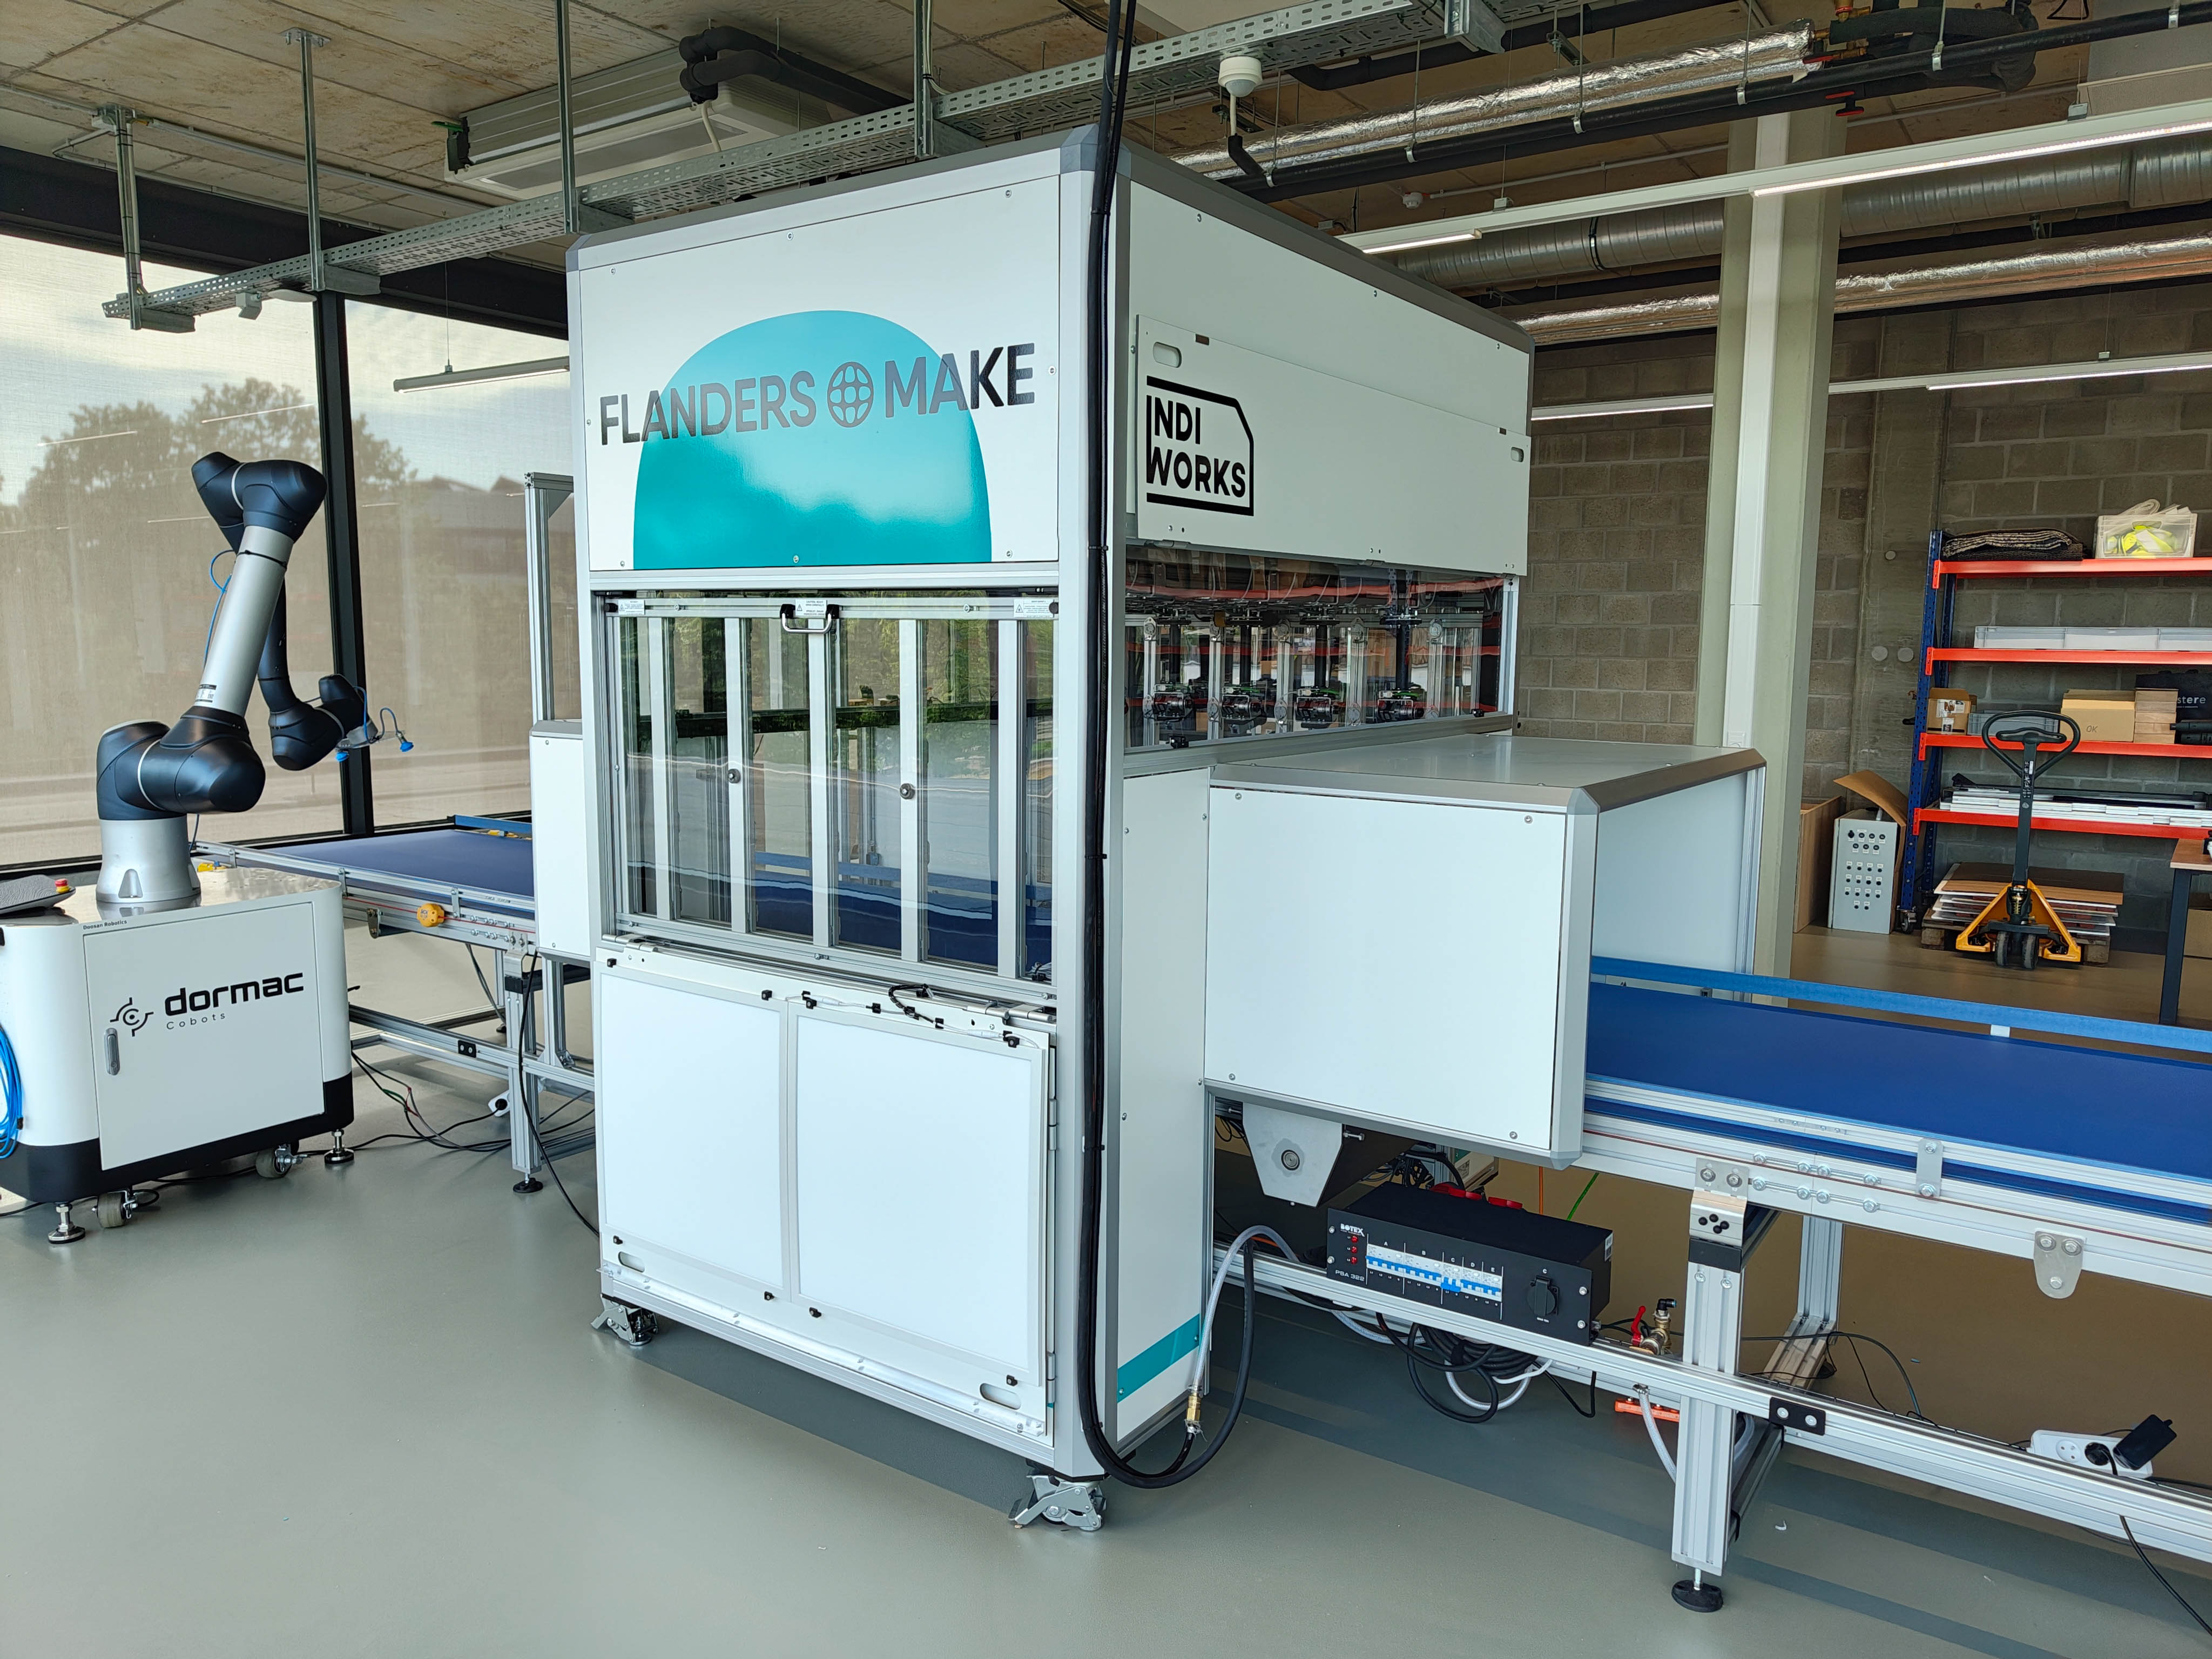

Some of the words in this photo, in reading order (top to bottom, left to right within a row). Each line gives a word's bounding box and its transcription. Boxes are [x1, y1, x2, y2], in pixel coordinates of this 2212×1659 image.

[600, 370, 817, 446] FLANDERS
[885, 342, 1035, 418] MAKE
[1146, 394, 1201, 444] INDI
[1146, 446, 1246, 498] WORKS
[164, 972, 304, 1016] dormac
[166, 1012, 226, 1030] Cobots
[1340, 1223, 1365, 1237] BOTEX
[1335, 1270, 1349, 1278] PBA
[1350, 1273, 1365, 1282] 322
